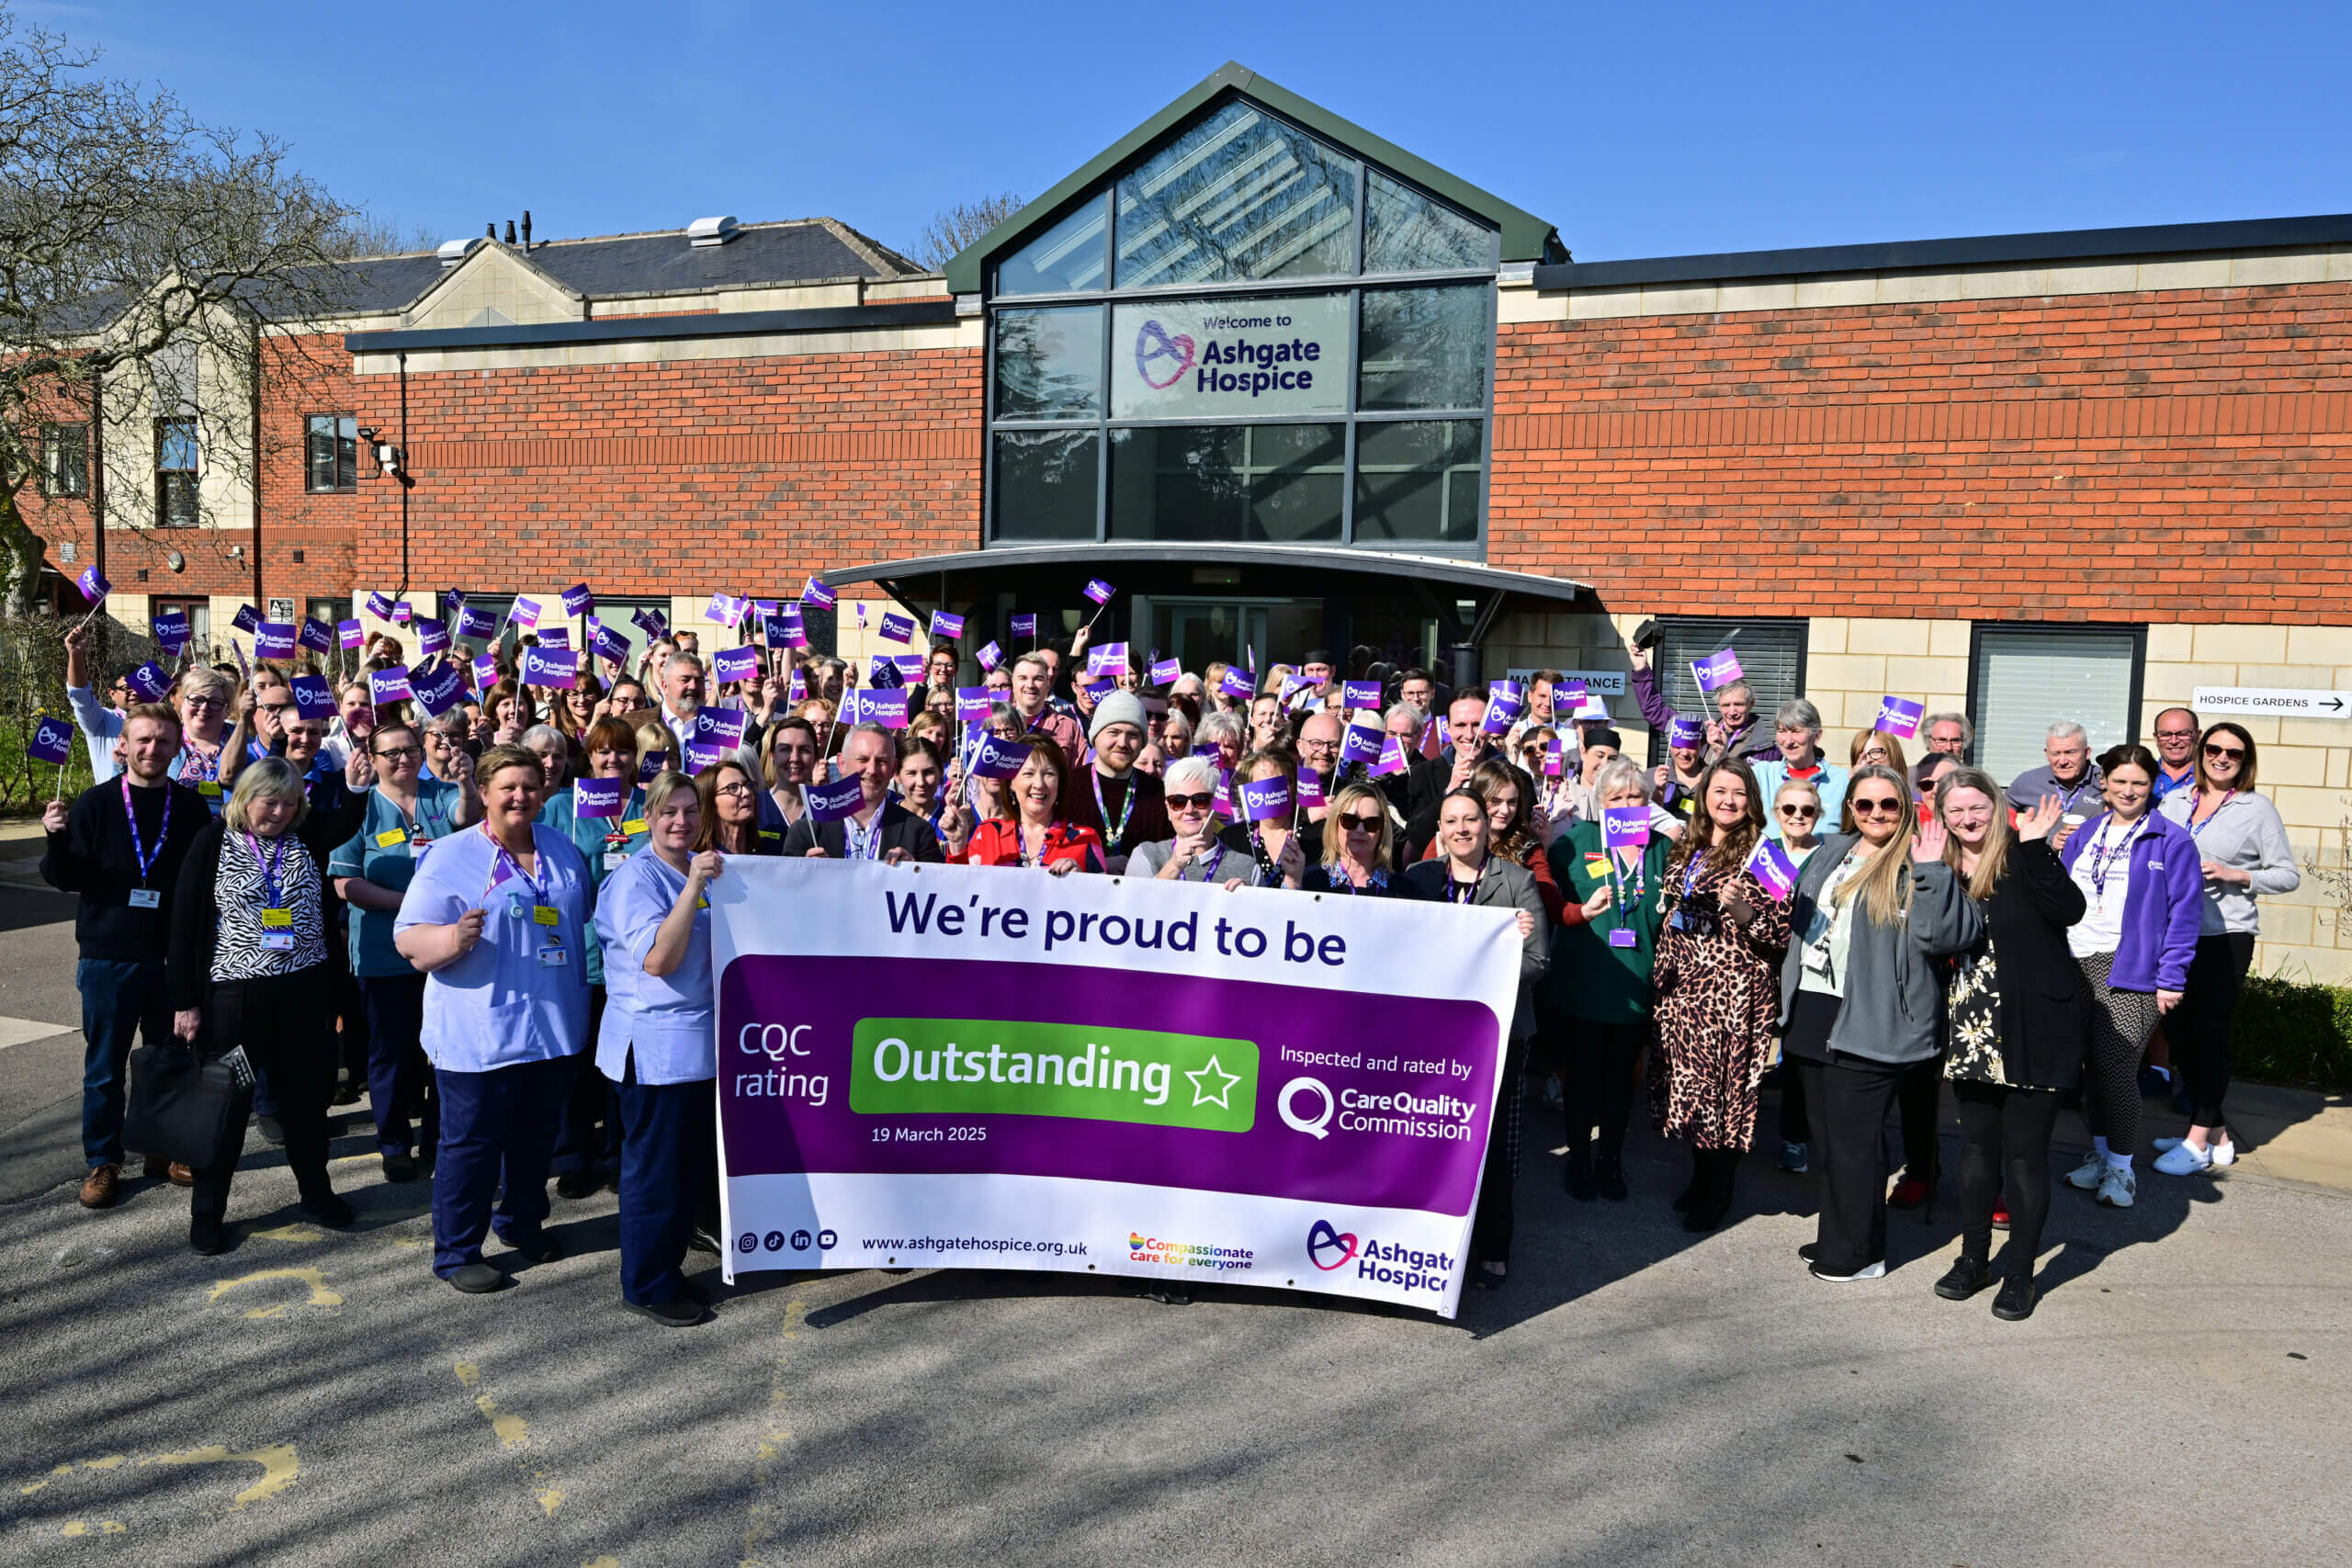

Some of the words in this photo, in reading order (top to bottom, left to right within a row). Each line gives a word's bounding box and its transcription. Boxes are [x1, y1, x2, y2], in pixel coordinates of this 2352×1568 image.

[1204, 316, 1272, 330] Welcome
[1276, 315, 1292, 327] to
[1202, 338, 1320, 369] Ashgate
[1197, 365, 1313, 397] Hospice
[892, 628, 910, 637] Hospice
[893, 624, 911, 632] Ashgate
[266, 641, 292, 649] Hospice
[545, 661, 575, 671] Ashgate
[731, 659, 754, 667] Ashgate
[1713, 660, 1736, 671] Ashgate
[543, 668, 572, 677] Hospice
[1713, 665, 1736, 677] Hospice
[435, 671, 458, 693] Ashgate
[436, 677, 459, 699] Hospice
[2199, 695, 2249, 705] HOSPICE
[2253, 698, 2309, 707] GARDENS
[875, 709, 905, 717] Hospice
[876, 703, 905, 712] Ashgate
[1885, 714, 1915, 728] Hospice
[1889, 709, 1918, 722] Ashgate
[714, 728, 740, 738] Hospice
[716, 722, 741, 732] Ashgate
[996, 761, 1021, 769] Hospice
[1001, 754, 1024, 764] Ashgate
[830, 787, 860, 804] Ashgate
[1265, 790, 1287, 800] Ashgate
[1265, 795, 1287, 807] Hospice
[588, 798, 618, 807] Hospice
[830, 794, 860, 810] Hospice
[1623, 819, 1647, 828] Ashgate
[1622, 826, 1645, 834] Hospice
[1045, 909, 1198, 952] proud
[1215, 918, 1268, 958] to
[1283, 919, 1347, 966] be
[739, 1022, 812, 1062] CQC
[1280, 1044, 1362, 1069] Inspected
[1366, 1058, 1398, 1072] and
[1404, 1058, 1446, 1076] rated
[1451, 1060, 1473, 1080] by
[873, 1037, 1170, 1106] Outstanding
[735, 1066, 829, 1107] rating
[1338, 1111, 1472, 1142] Commission
[871, 1128, 890, 1142] 19
[895, 1127, 944, 1141] March
[947, 1127, 988, 1141] 2025
[862, 1235, 1088, 1257] www.ashgatehospice.org.uk
[1146, 1237, 1254, 1258] Compassionate
[1130, 1251, 1160, 1263] care
[1164, 1252, 1185, 1265] for
[1188, 1257, 1253, 1270] everyone
